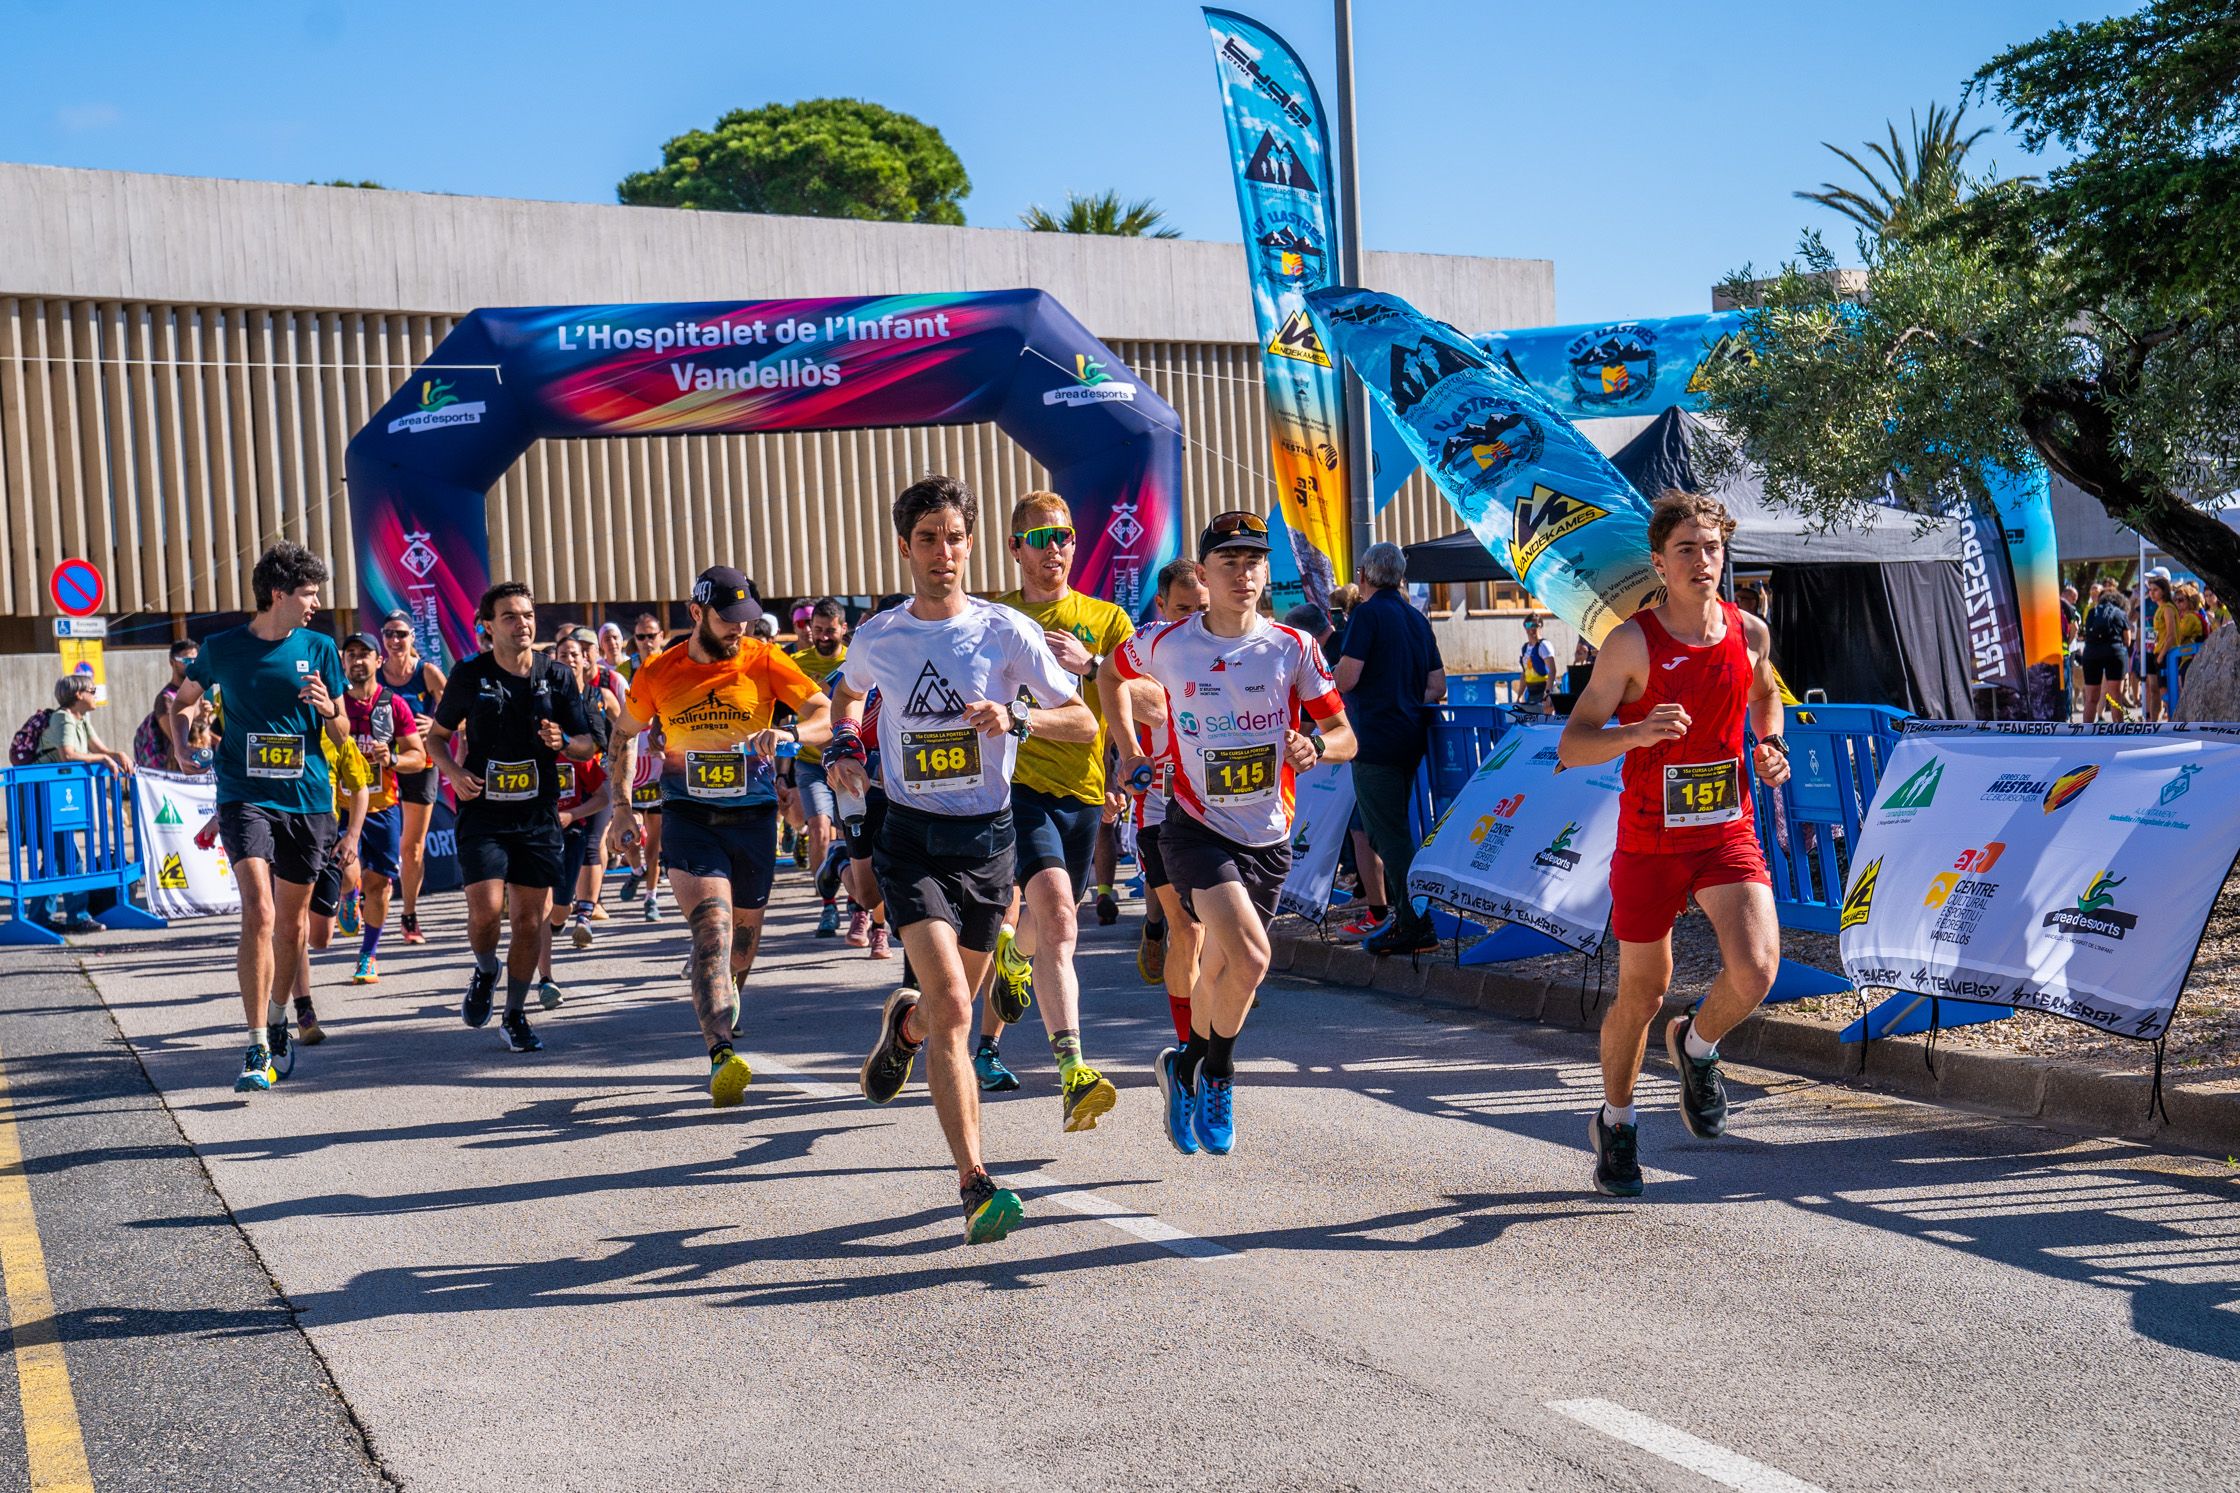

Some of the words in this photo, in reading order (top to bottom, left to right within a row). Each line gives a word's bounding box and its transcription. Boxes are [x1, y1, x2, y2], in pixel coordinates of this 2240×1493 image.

[1221, 50, 1251, 77] ACTIVE
[1253, 78, 1280, 105] WEAR
[775, 318, 817, 344] de
[1568, 334, 1590, 355] UT
[1593, 325, 1658, 345] LLASTRES
[671, 358, 841, 392] Vandellòs
[1080, 388, 1129, 399] d'esports
[423, 412, 476, 424] d'esports
[1517, 508, 1596, 573] VANDEKAMES
[1608, 567, 1649, 592] Vandellòs
[1610, 592, 1620, 602] de
[429, 638, 440, 653] de
[690, 723, 728, 731] zaragoza
[1206, 708, 1284, 732] saldent
[1997, 723, 2059, 735] TEAMERGY
[2091, 723, 2162, 735] TEAMERGY
[259, 747, 293, 765] 167
[916, 747, 966, 772] 168
[497, 774, 529, 788] 170
[698, 766, 735, 782] 145
[1220, 762, 1264, 787] 115
[635, 789, 657, 800] 171
[1682, 780, 1726, 805] 157
[1986, 780, 2048, 794] MESTRAL
[1955, 880, 1999, 898] CENTRE
[1947, 894, 1988, 910] CULTURAL
[1941, 906, 1977, 921] ESPORTIU
[1935, 917, 1977, 933] RECREATIU
[1930, 930, 1970, 945] VANDELLÒS
